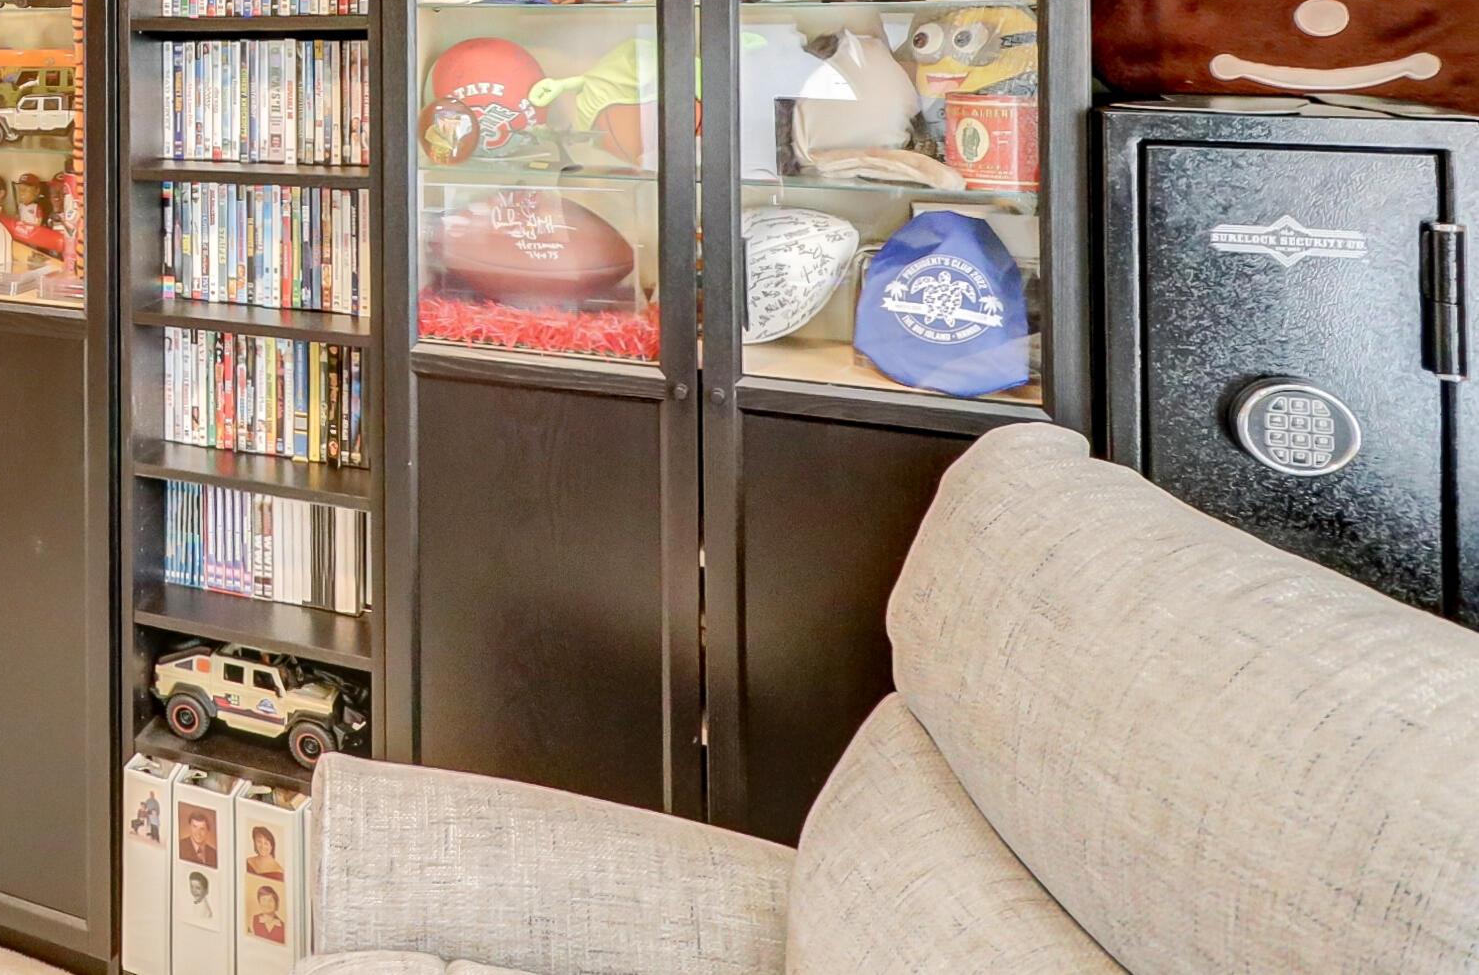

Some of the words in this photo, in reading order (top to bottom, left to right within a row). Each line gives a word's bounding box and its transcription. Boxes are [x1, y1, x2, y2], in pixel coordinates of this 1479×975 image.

[447, 81, 505, 101] TATE
[1211, 233, 1277, 246] SURELOCK
[1280, 236, 1344, 248] SECURITY
[902, 257, 951, 279] PRESIDENT'S
[951, 258, 974, 273] CLUB
[970, 272, 988, 289] 2022
